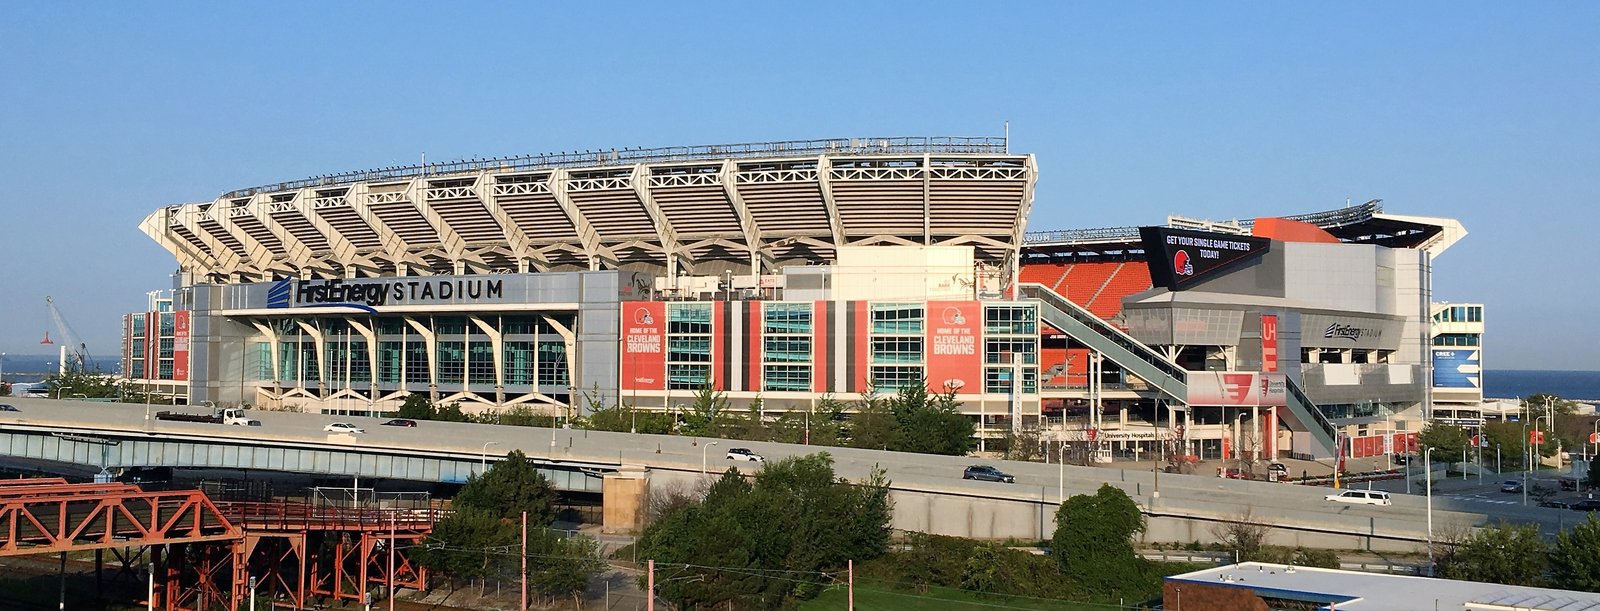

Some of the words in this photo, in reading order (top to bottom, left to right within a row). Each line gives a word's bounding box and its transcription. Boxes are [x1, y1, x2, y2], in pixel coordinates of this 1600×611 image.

[1166, 235, 1177, 245] GET
[1178, 236, 1193, 246] YOUR
[1193, 238, 1213, 249] SINGLE
[1213, 239, 1229, 250] GAME
[1229, 241, 1250, 252] TICKETS
[1200, 249, 1220, 259] TODAY!
[296, 278, 390, 306] FirstEnergy
[393, 279, 503, 301] STADIUM
[1334, 323, 1360, 339] FirstEnergy
[1360, 328, 1383, 338] STADIUM
[627, 335, 661, 343] CLEVELAND
[934, 335, 975, 344] CLEVELAND
[627, 343, 661, 353] BROWNS
[934, 344, 975, 355] BROWNS
